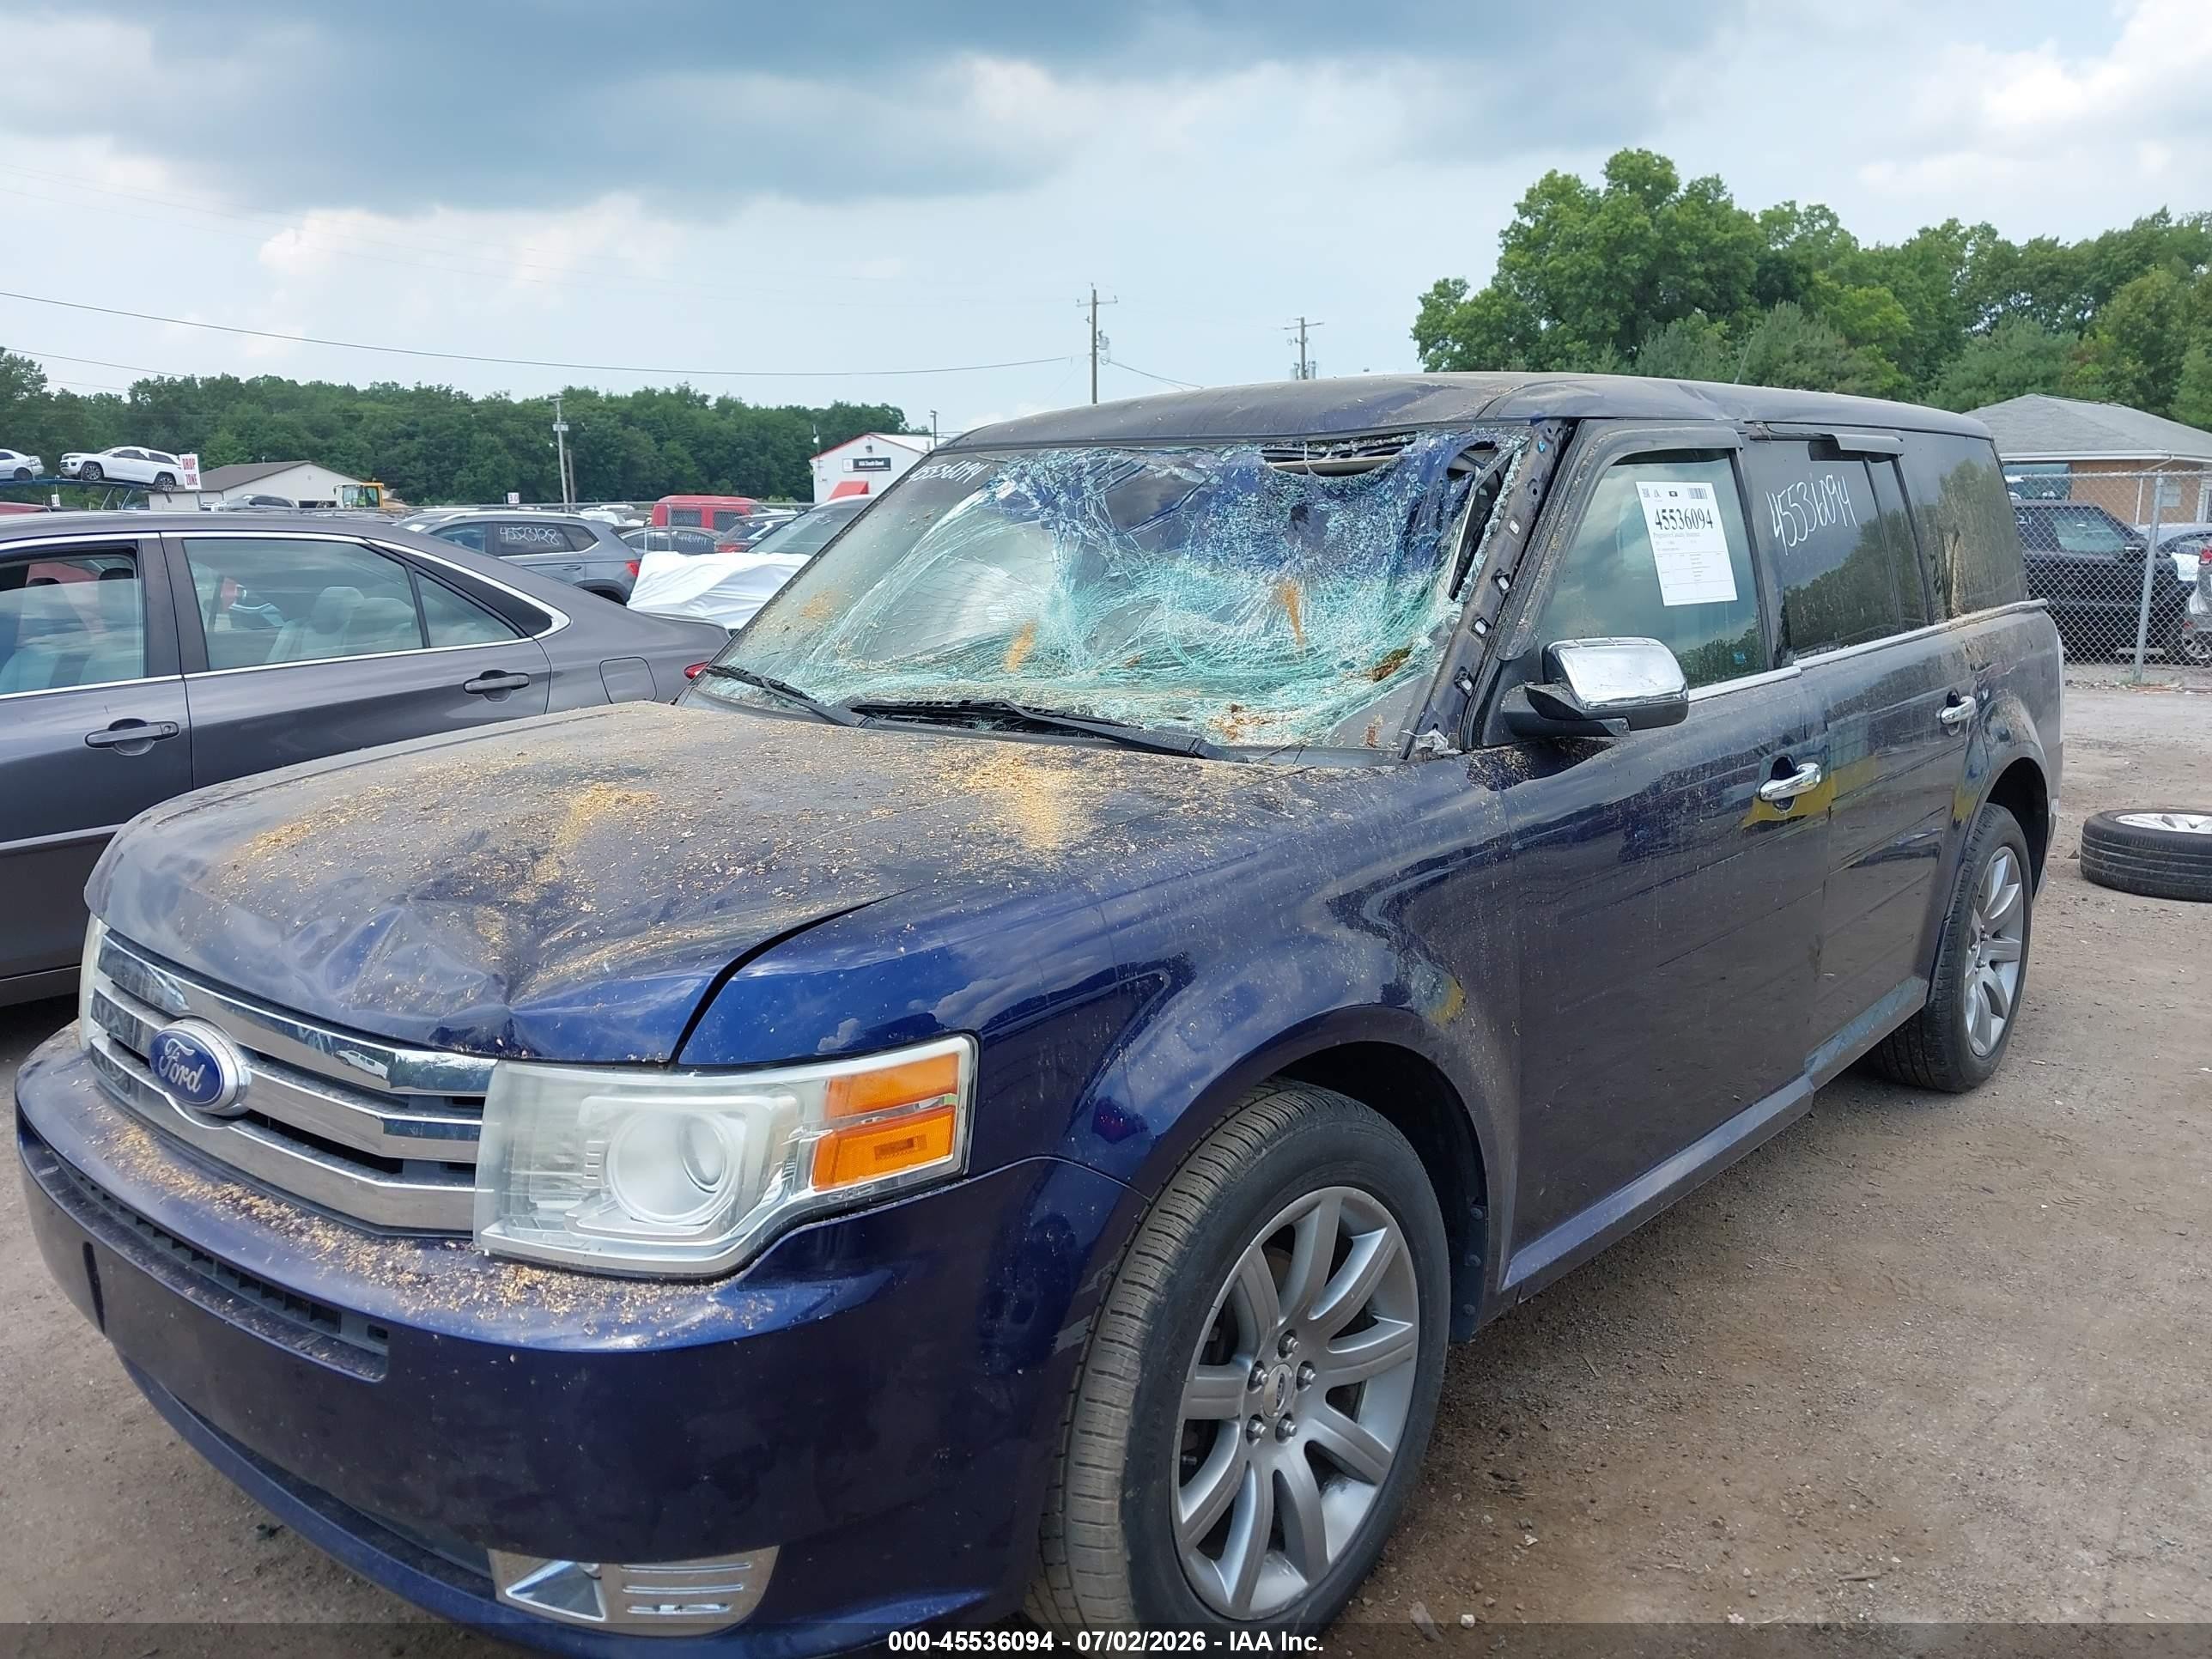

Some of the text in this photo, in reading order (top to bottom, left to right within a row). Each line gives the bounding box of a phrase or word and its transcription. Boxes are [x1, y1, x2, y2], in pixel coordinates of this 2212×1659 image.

[182, 459, 195, 470] DROP
[1656, 508, 1713, 530] 45536094
[1765, 474, 1857, 556] 45536094
[159, 1038, 205, 1093] Ford
